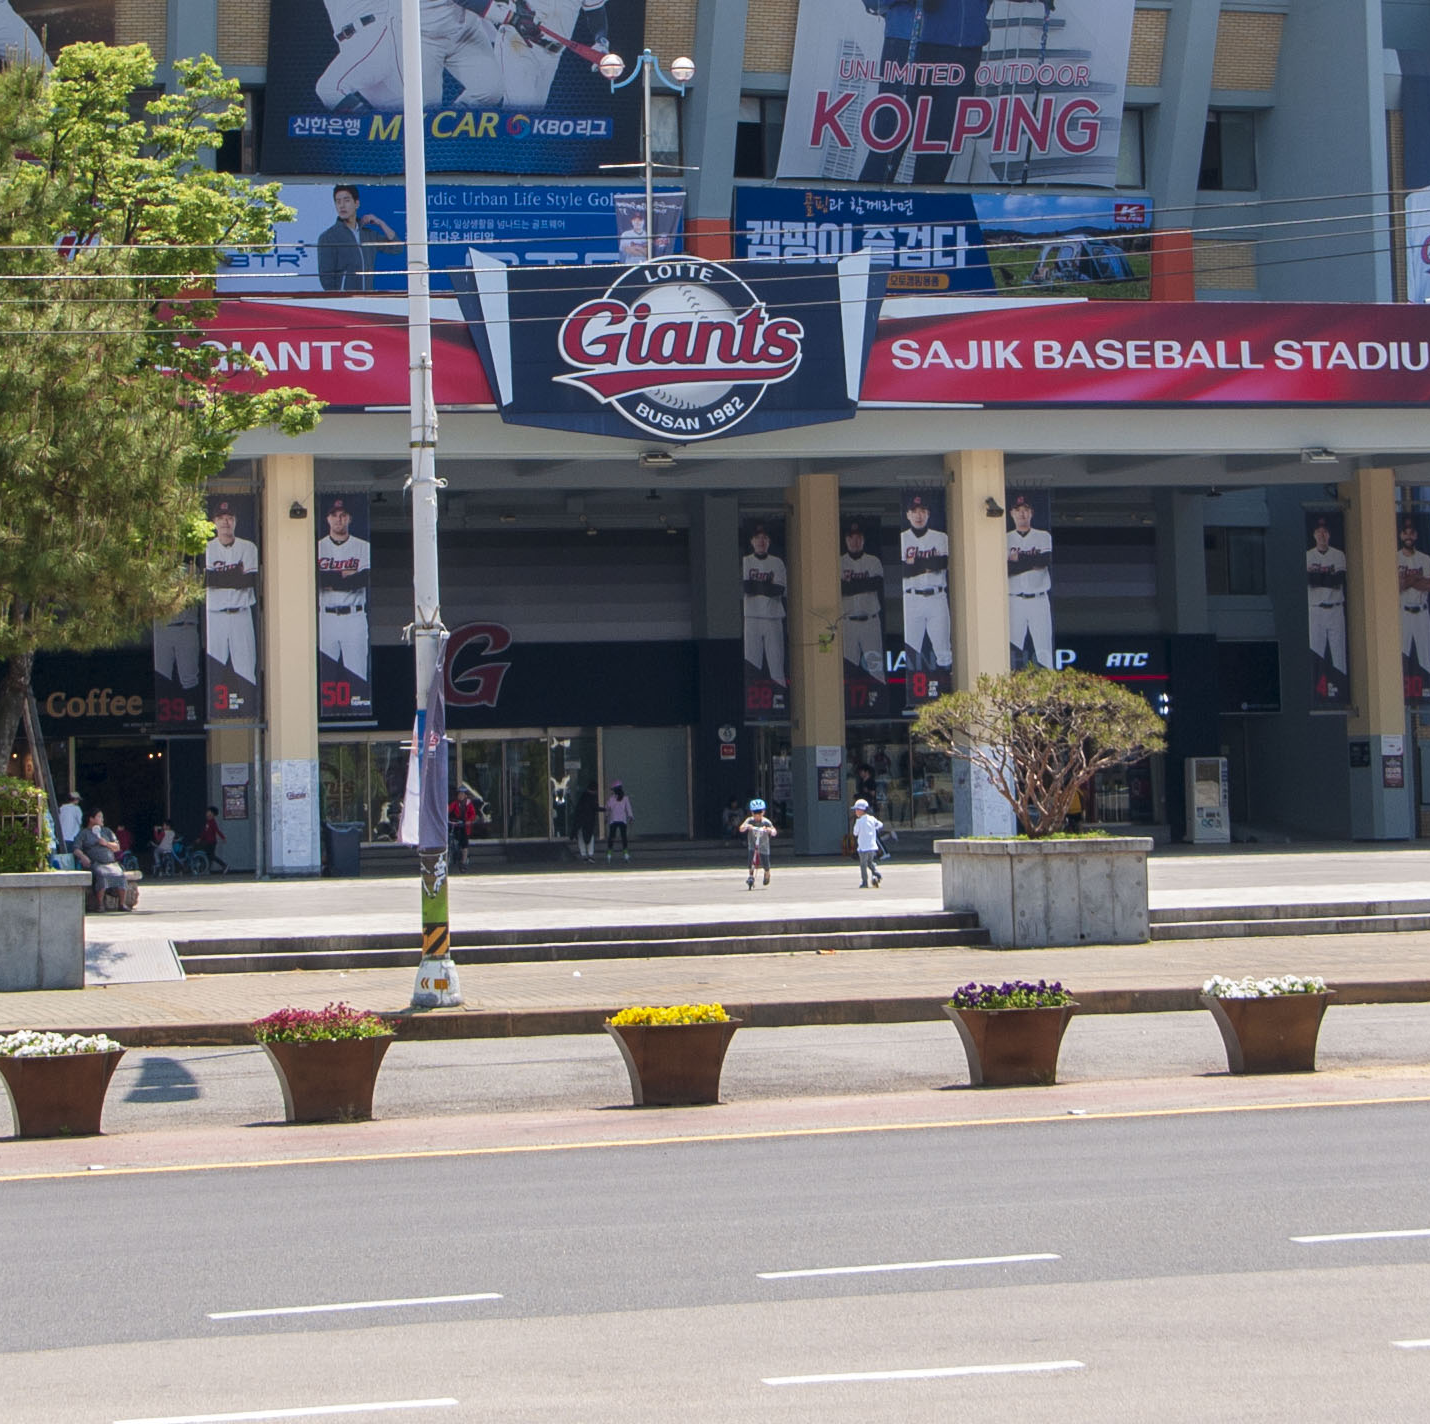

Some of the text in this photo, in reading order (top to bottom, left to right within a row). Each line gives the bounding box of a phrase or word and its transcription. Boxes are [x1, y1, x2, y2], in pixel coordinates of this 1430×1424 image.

[838, 58, 1090, 87] UNLIMITED OUTDOOR
[292, 116, 361, 137] 신한은행
[368, 114, 410, 140] M
[430, 111, 500, 138] CAR
[809, 90, 1102, 155] KOLPING
[427, 191, 457, 206] rdic
[462, 191, 508, 206] Urban
[513, 191, 541, 206] Life
[546, 191, 583, 209] Style
[803, 192, 914, 217] 콜핑과 함께라면
[432, 218, 566, 230] 도시, 일상생활을 넘나드는 골프웨어
[746, 220, 970, 269] 캠핑이 즐겁다
[644, 264, 714, 284] LOTTE
[560, 300, 804, 366] Giants
[891, 340, 1023, 370] SAJIK
[1035, 339, 1263, 370] BASEBALL
[634, 396, 745, 431] BUSAN 1982
[444, 622, 512, 707] G
[1107, 653, 1149, 667] ATC
[214, 684, 228, 709] 3
[322, 681, 350, 707] 50
[913, 672, 926, 697] 8
[1317, 674, 1328, 696] 4
[46, 687, 143, 718] Coffee
[158, 698, 186, 721] 39
[746, 686, 773, 709] 28
